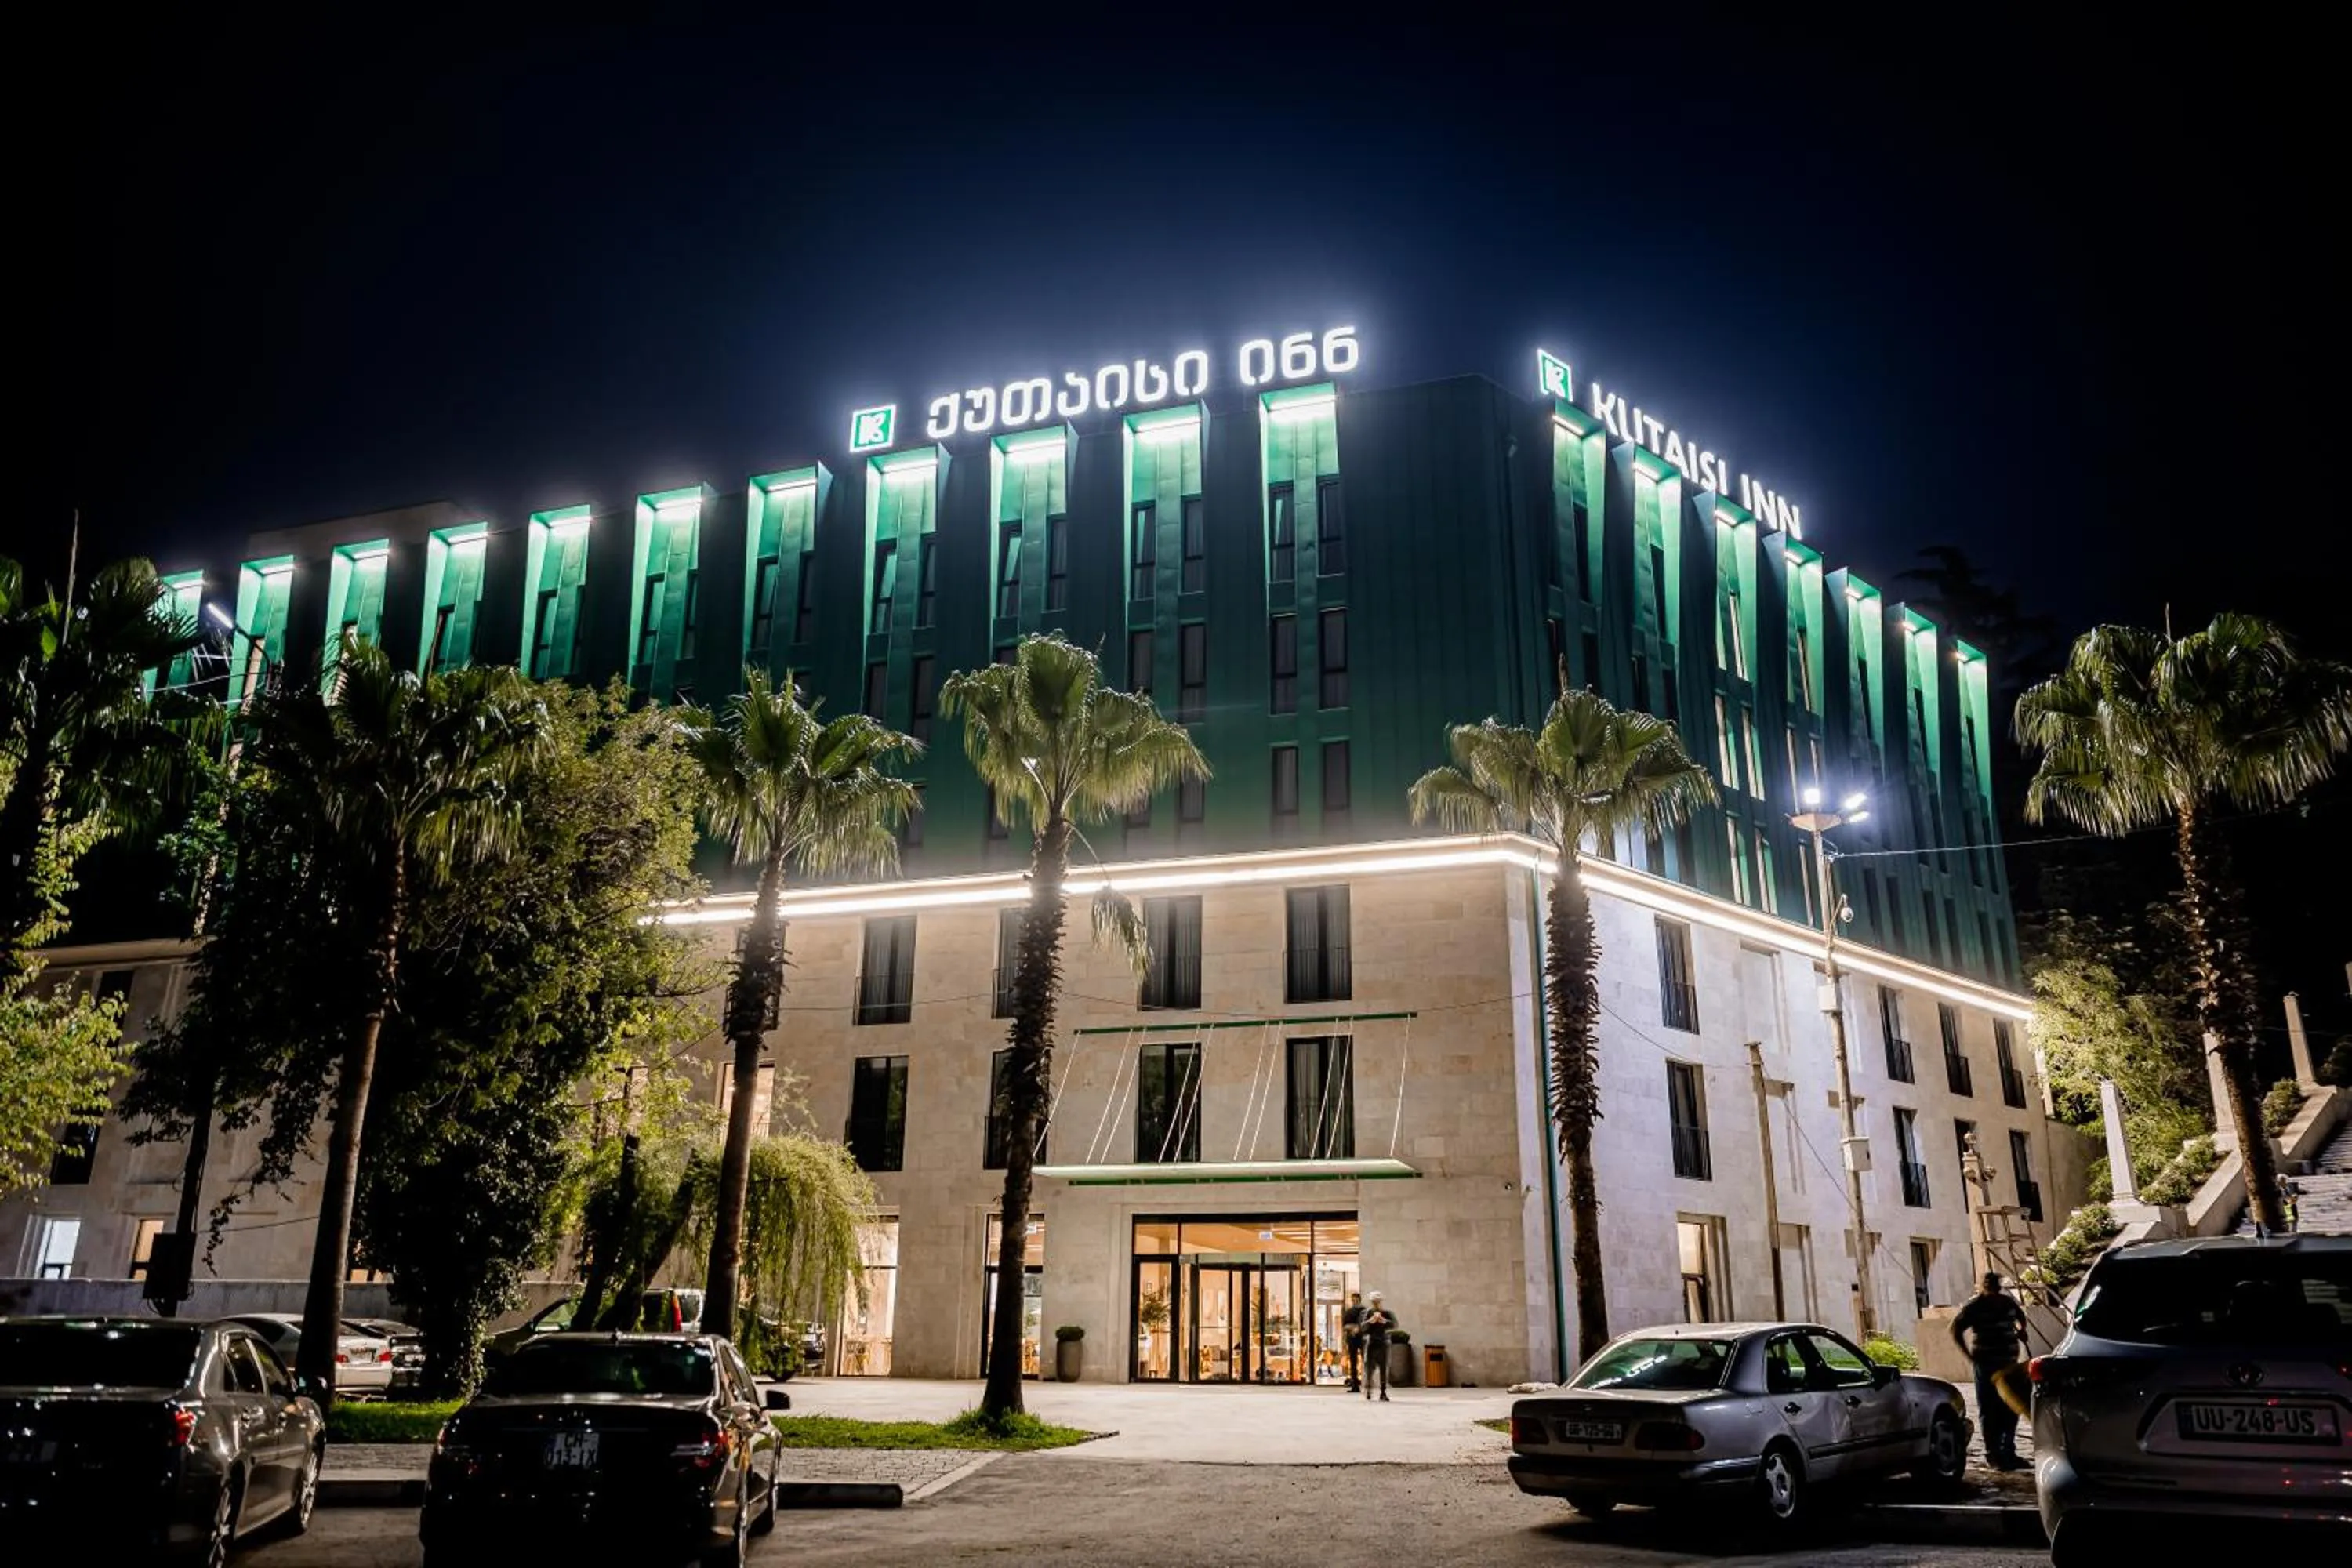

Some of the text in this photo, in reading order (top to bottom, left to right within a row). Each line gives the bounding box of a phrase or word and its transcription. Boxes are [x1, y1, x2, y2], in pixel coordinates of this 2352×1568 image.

[927, 325, 1360, 438] ქუთაისი ინნ
[858, 412, 887, 445] K
[1592, 382, 1802, 541] KUTAISI INN
[2195, 1406, 2315, 1436] UU-248-US
